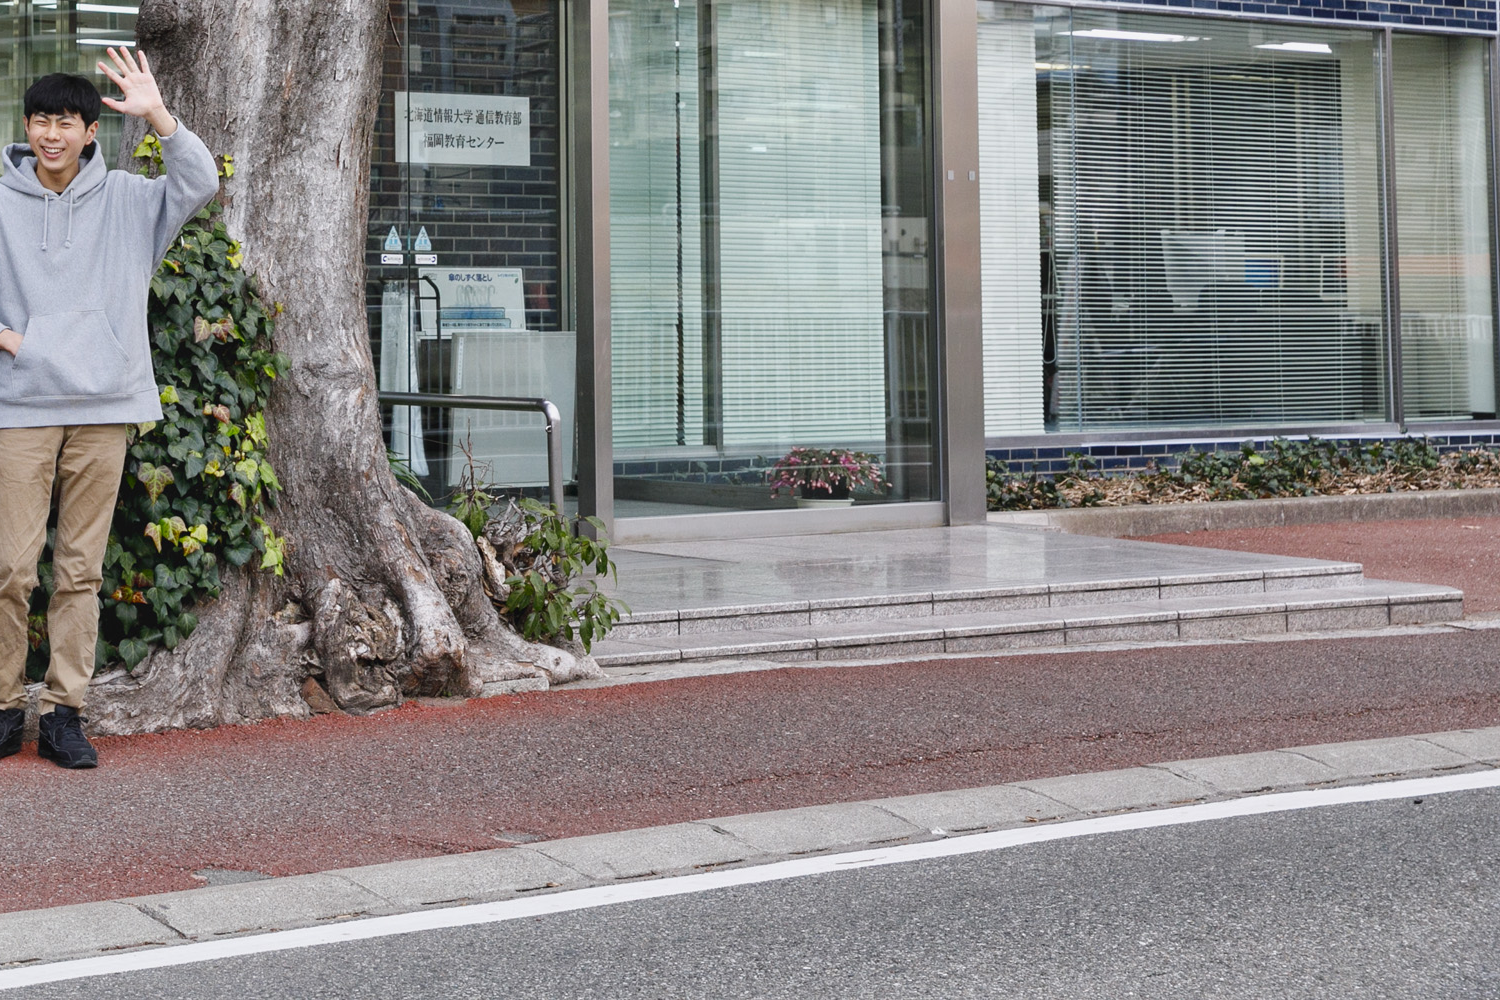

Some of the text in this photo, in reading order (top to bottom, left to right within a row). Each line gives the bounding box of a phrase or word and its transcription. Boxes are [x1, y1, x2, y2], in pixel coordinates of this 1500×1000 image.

[423, 133, 505, 149] 福岡教育センター
